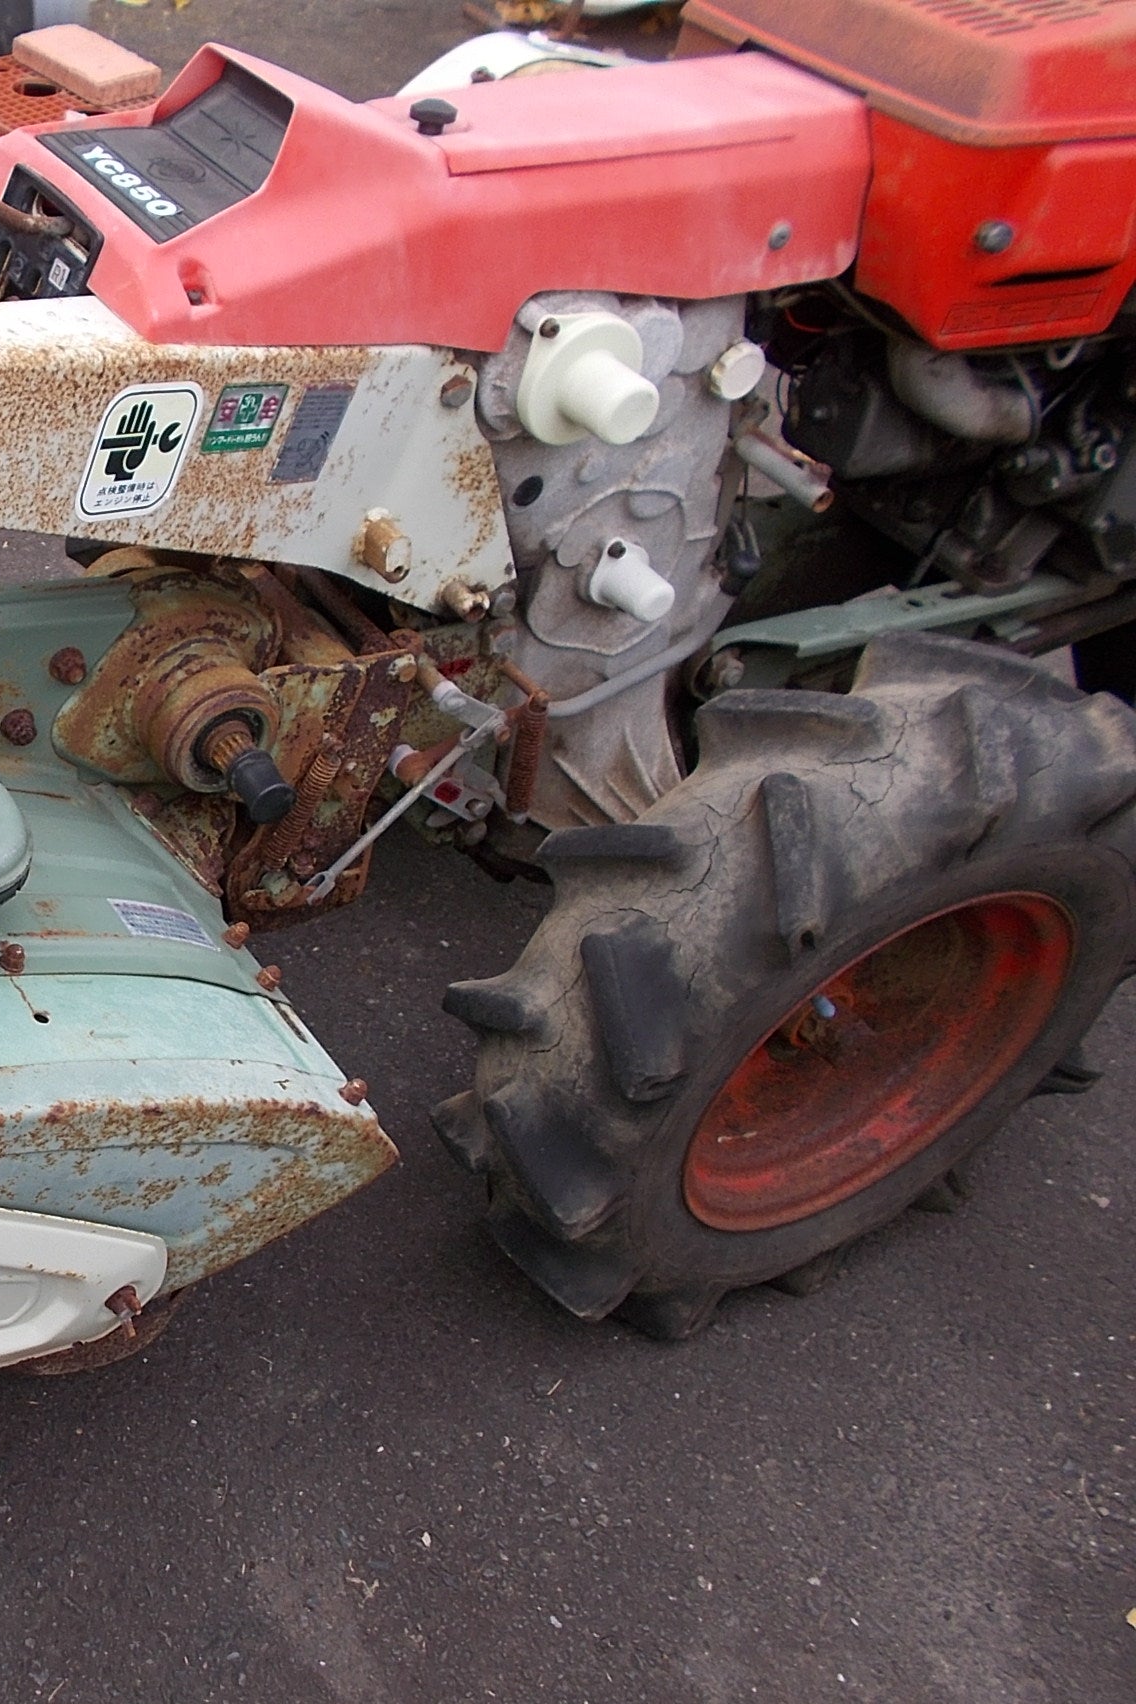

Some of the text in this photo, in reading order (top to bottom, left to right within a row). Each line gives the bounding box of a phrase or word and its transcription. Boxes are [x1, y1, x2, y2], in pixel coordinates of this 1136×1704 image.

[82, 145, 178, 217] YC850
[96, 482, 155, 496] 点検整備時は
[93, 494, 151, 507] エンジン停止
